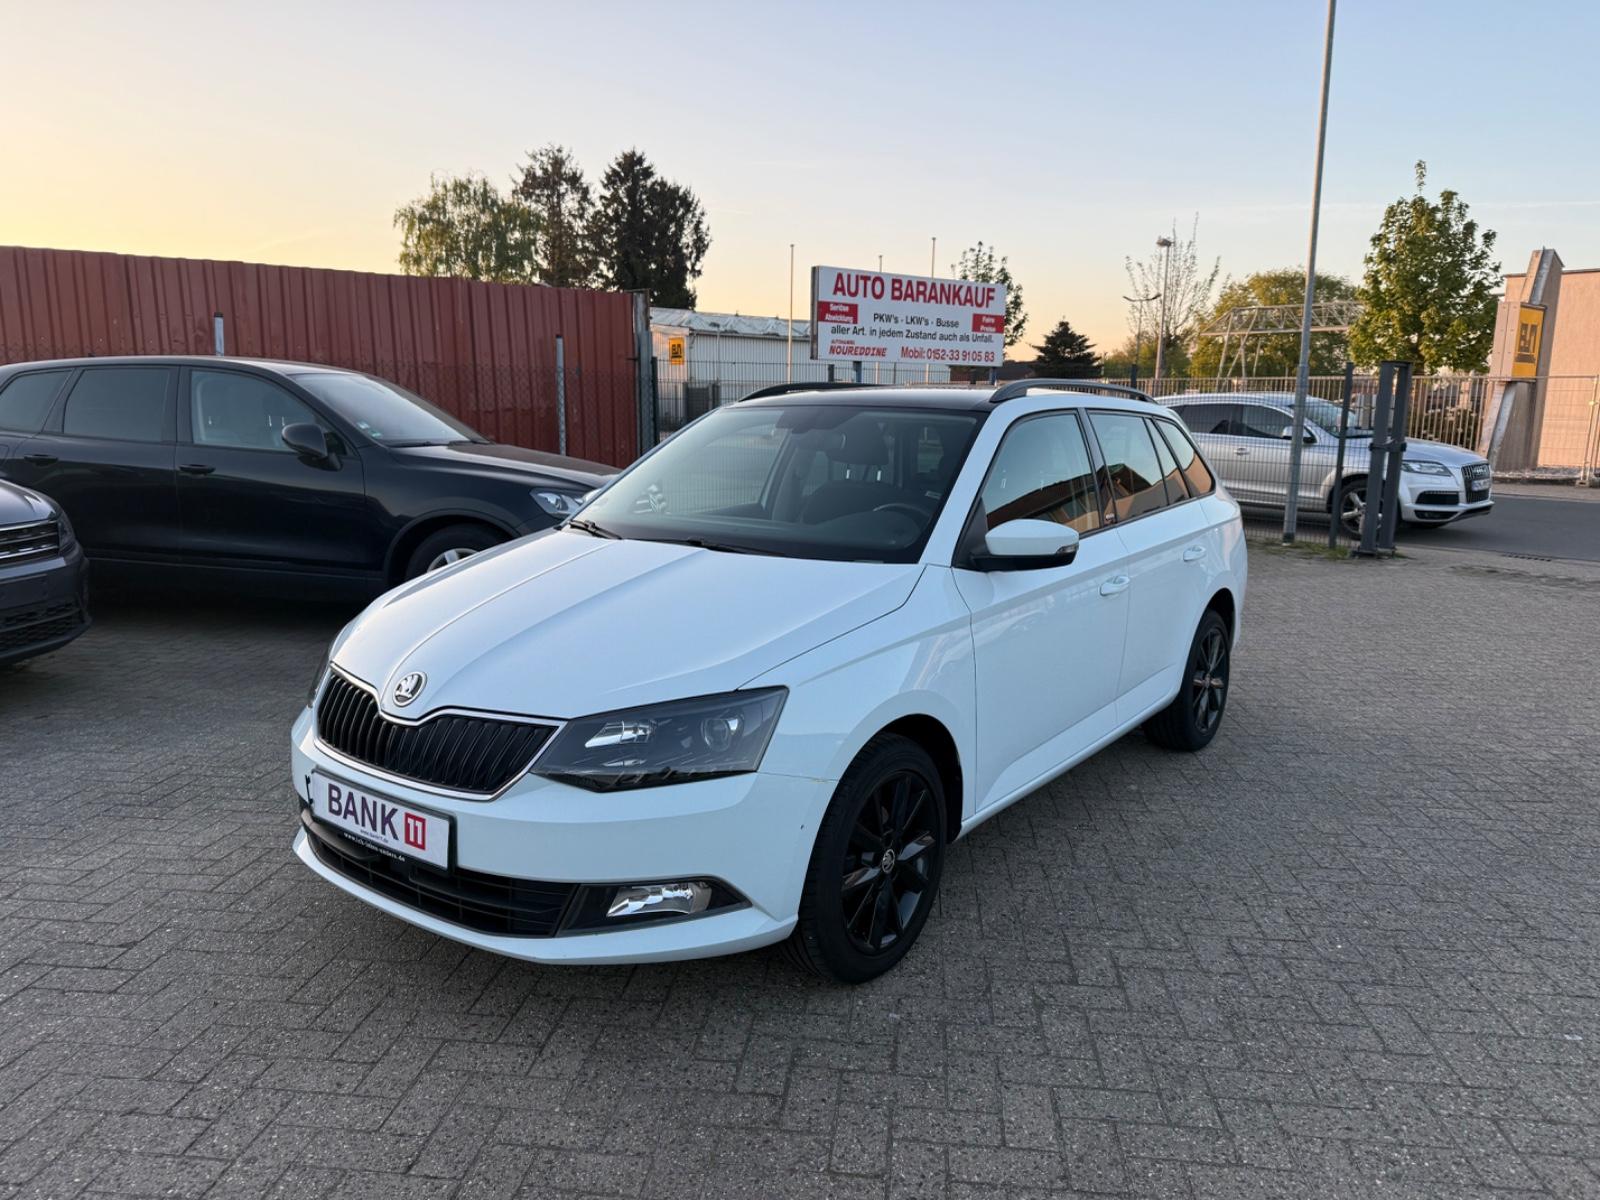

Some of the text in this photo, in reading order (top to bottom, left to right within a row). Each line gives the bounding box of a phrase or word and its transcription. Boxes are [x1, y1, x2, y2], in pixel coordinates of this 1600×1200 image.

[832, 271, 996, 309] AUTO BARANKAUF
[873, 312, 899, 325] PKW's
[905, 315, 929, 326] LKW's
[935, 317, 960, 328] Busse
[830, 325, 850, 335] aller
[869, 326, 877, 336] in
[878, 327, 904, 339] jedem
[905, 329, 937, 341] Zustand
[938, 332, 958, 342] auch
[958, 333, 970, 342] als
[828, 345, 888, 357] NOUREDDINE
[900, 346, 926, 359] Mobil:
[328, 783, 424, 846] BANK 11
